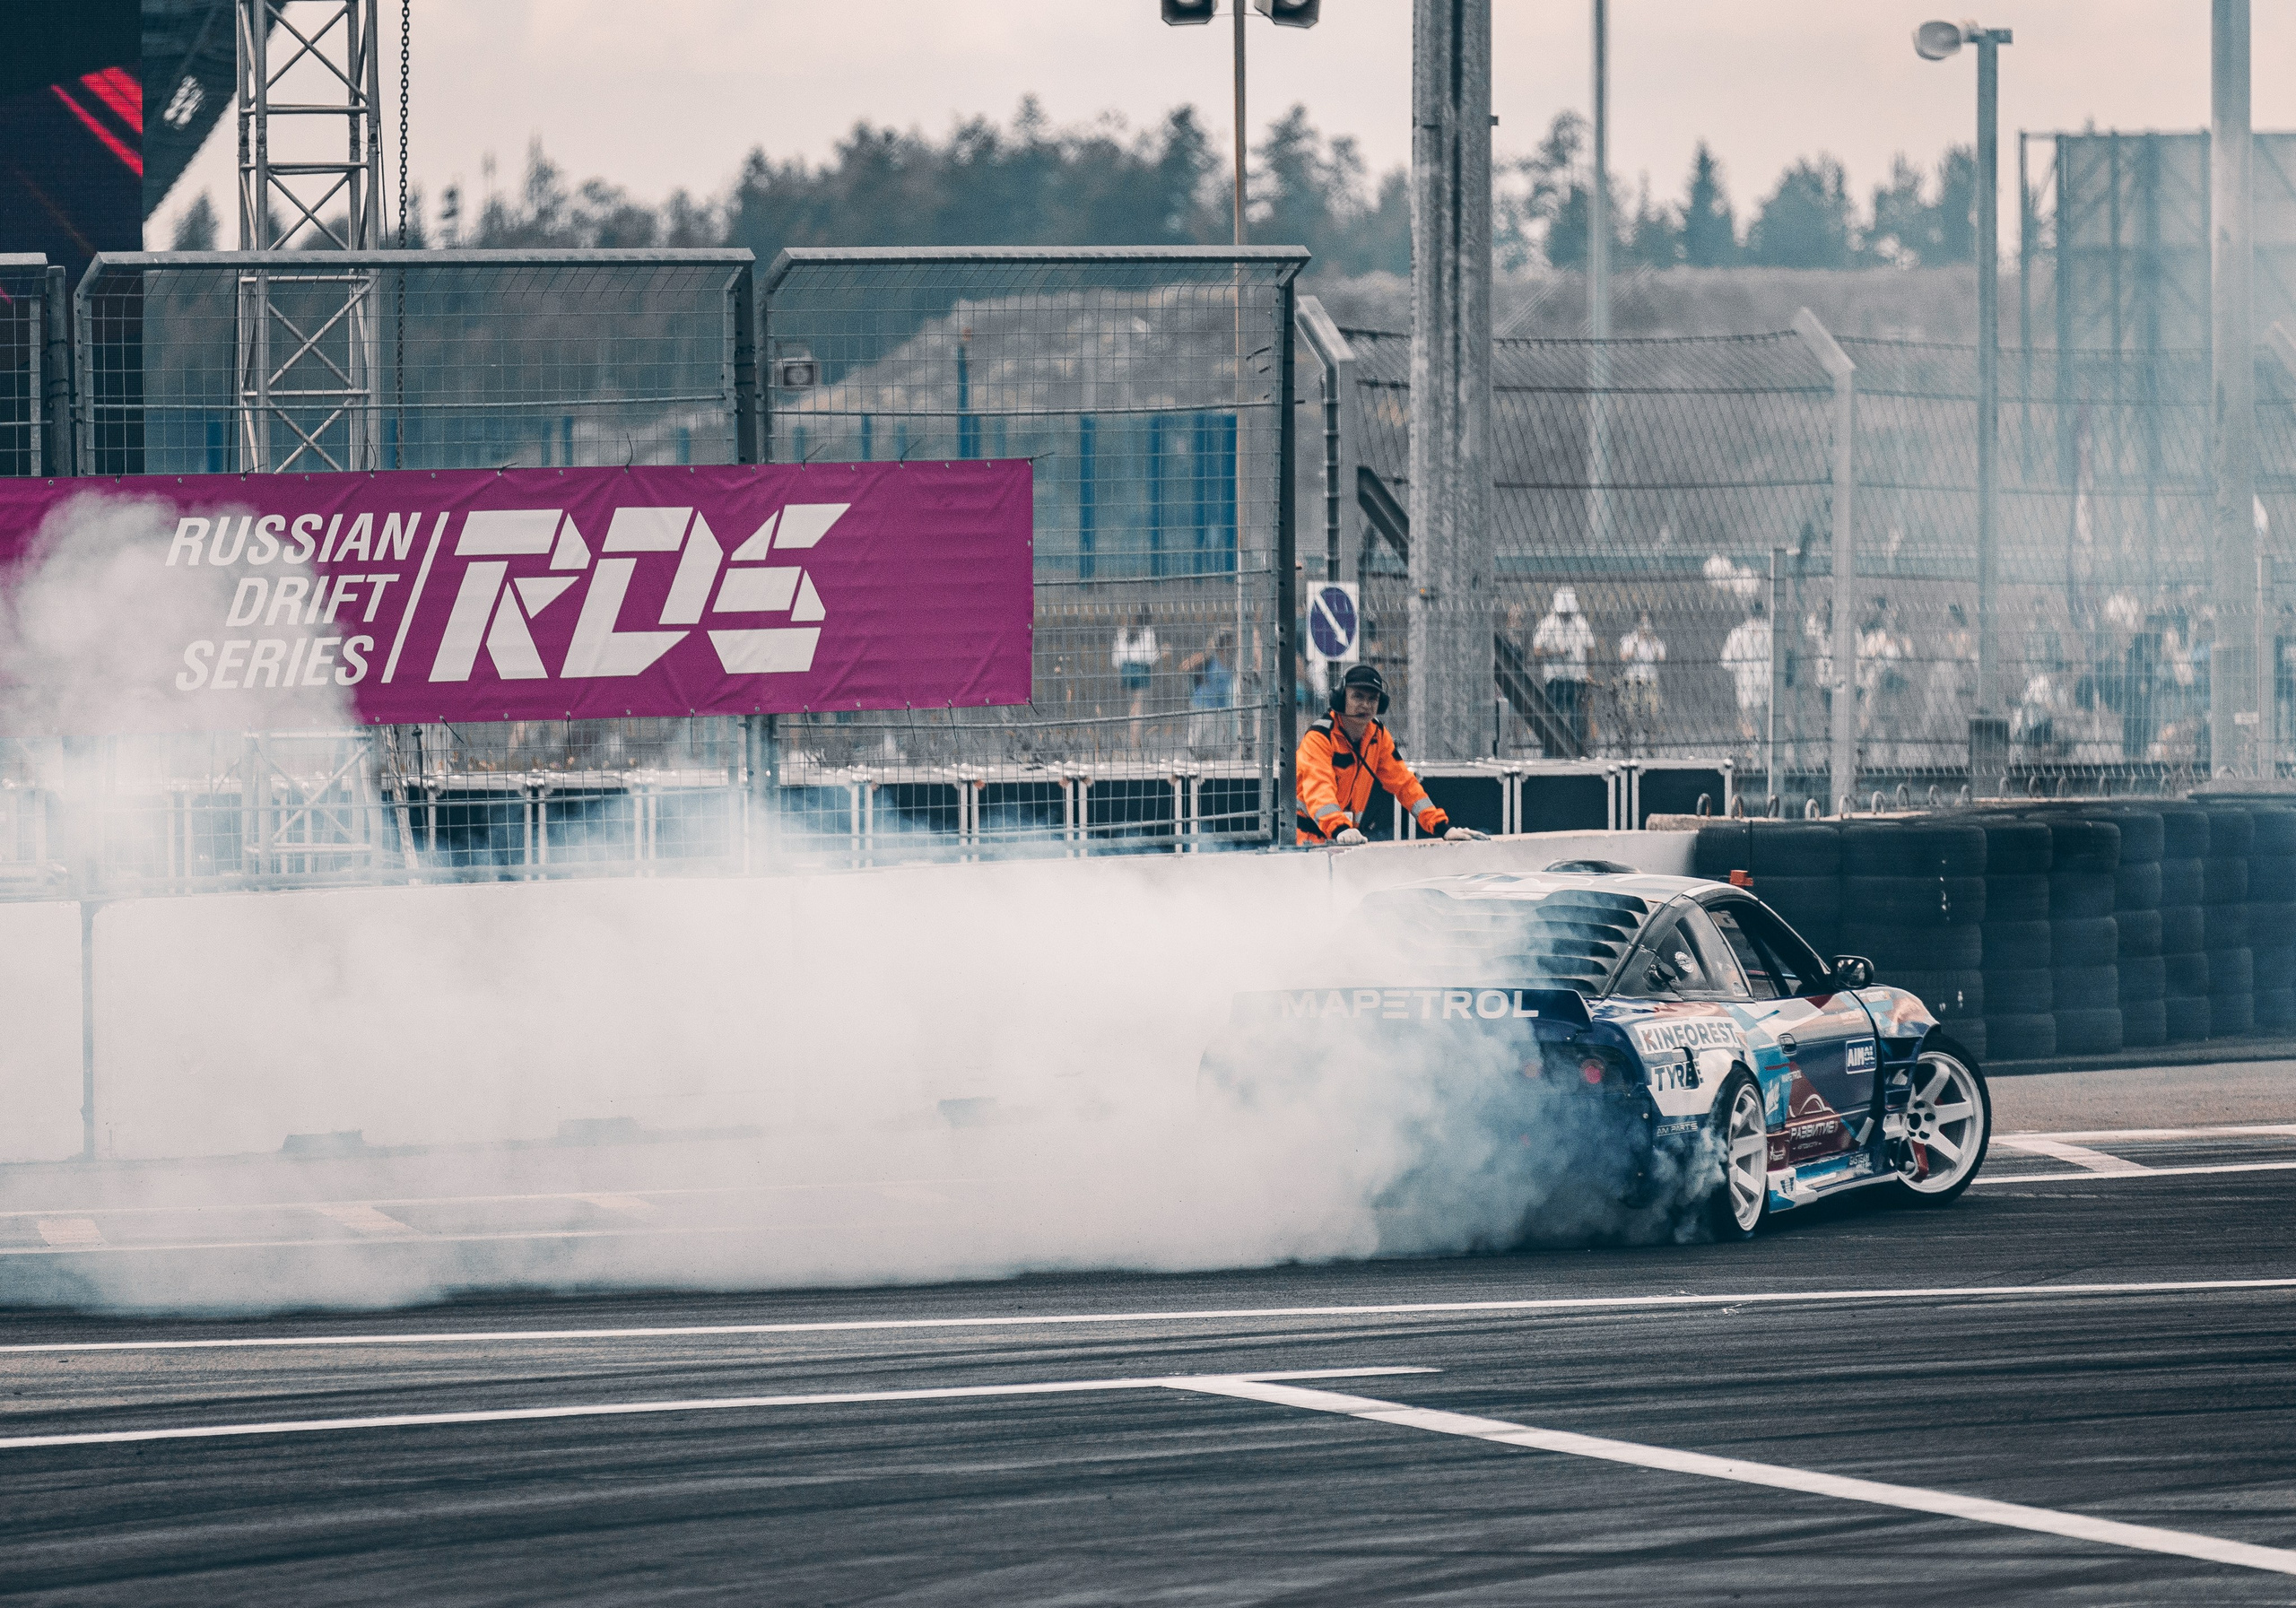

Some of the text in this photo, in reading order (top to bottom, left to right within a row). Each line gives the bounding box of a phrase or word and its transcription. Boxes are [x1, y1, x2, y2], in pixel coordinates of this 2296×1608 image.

[165, 512, 422, 566] RUSSIAN
[225, 573, 400, 627] DRIFT
[428, 502, 851, 682] RDS
[175, 635, 374, 691] SERIES
[1280, 989, 1539, 1020] MAPETROL
[1640, 1022, 1738, 1052] KINFOREST
